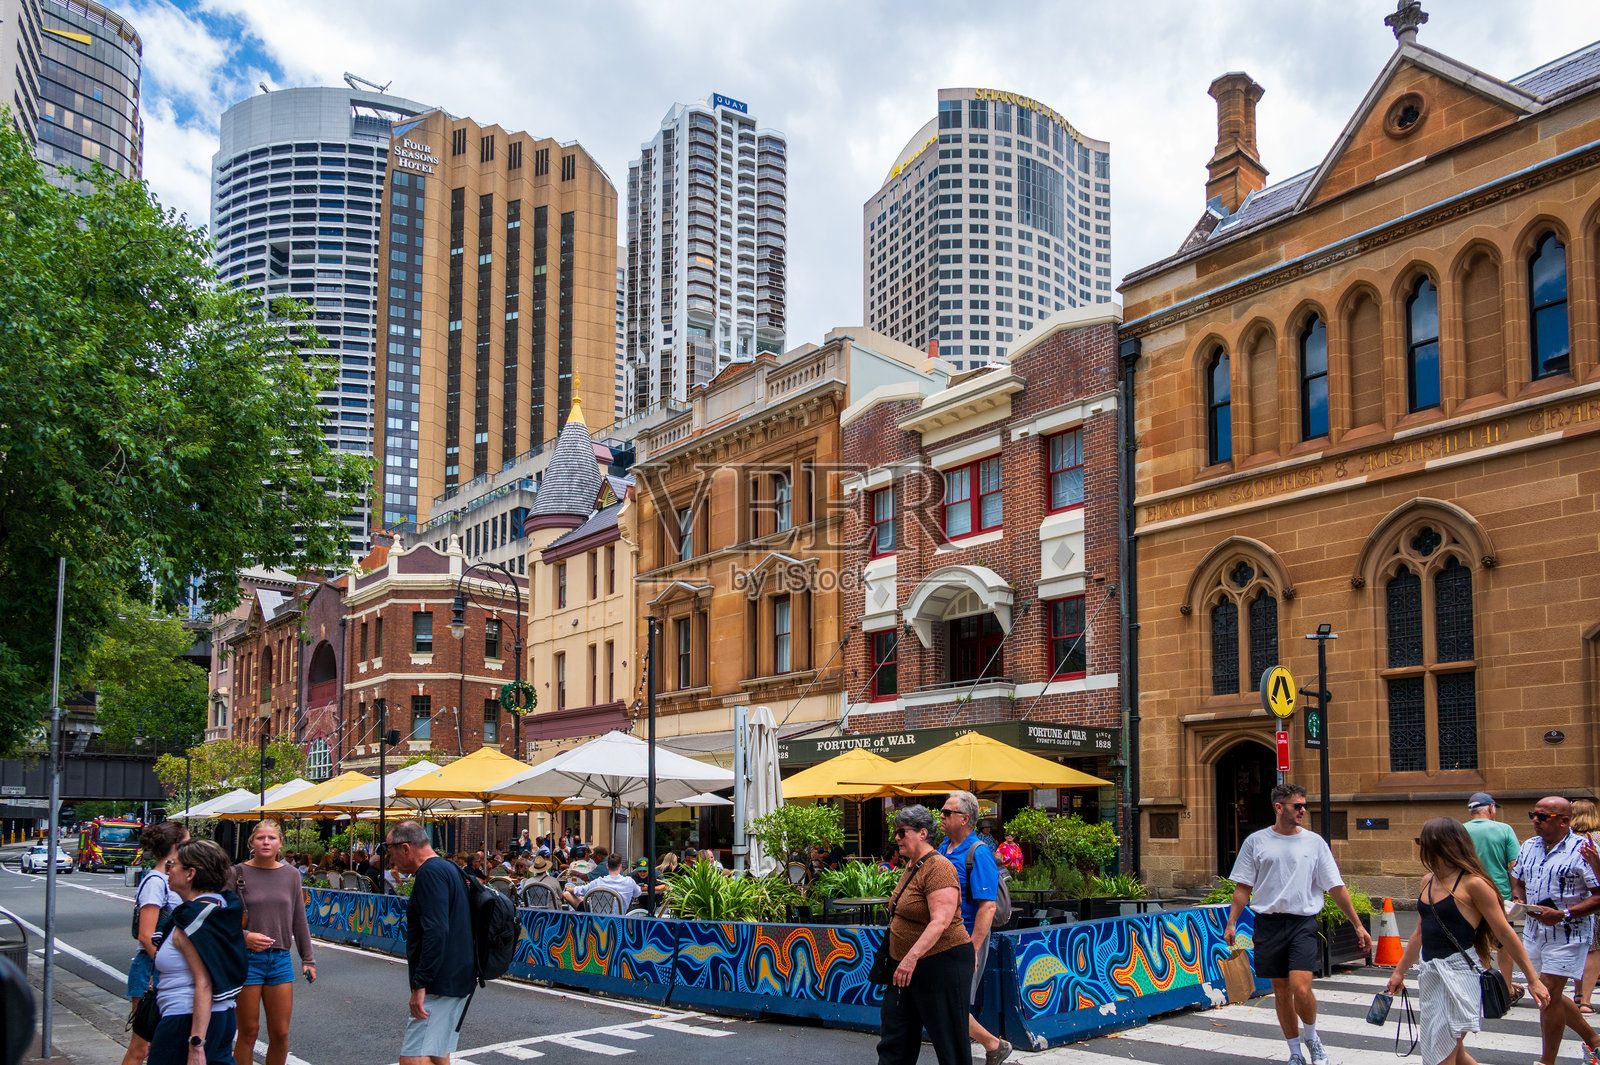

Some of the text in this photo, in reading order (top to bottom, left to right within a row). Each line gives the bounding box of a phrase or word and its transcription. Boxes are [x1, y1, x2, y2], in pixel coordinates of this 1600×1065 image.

[717, 96, 744, 110] QUAY
[975, 88, 1055, 120] SHANGRI-LA
[403, 138, 431, 153] FOUR
[394, 145, 439, 165] SEASONS
[398, 157, 435, 174] HOTEL
[1144, 491, 1218, 523] ENGLISH
[1229, 465, 1324, 503] SCOTTISH
[1335, 459, 1348, 479] &
[1359, 419, 1510, 472] AUSTRALIAN
[1028, 726, 1087, 741] FORTUNE of WAR
[1095, 732, 1112, 740] SINCE
[817, 735, 916, 751] FORTUNE of WAR
